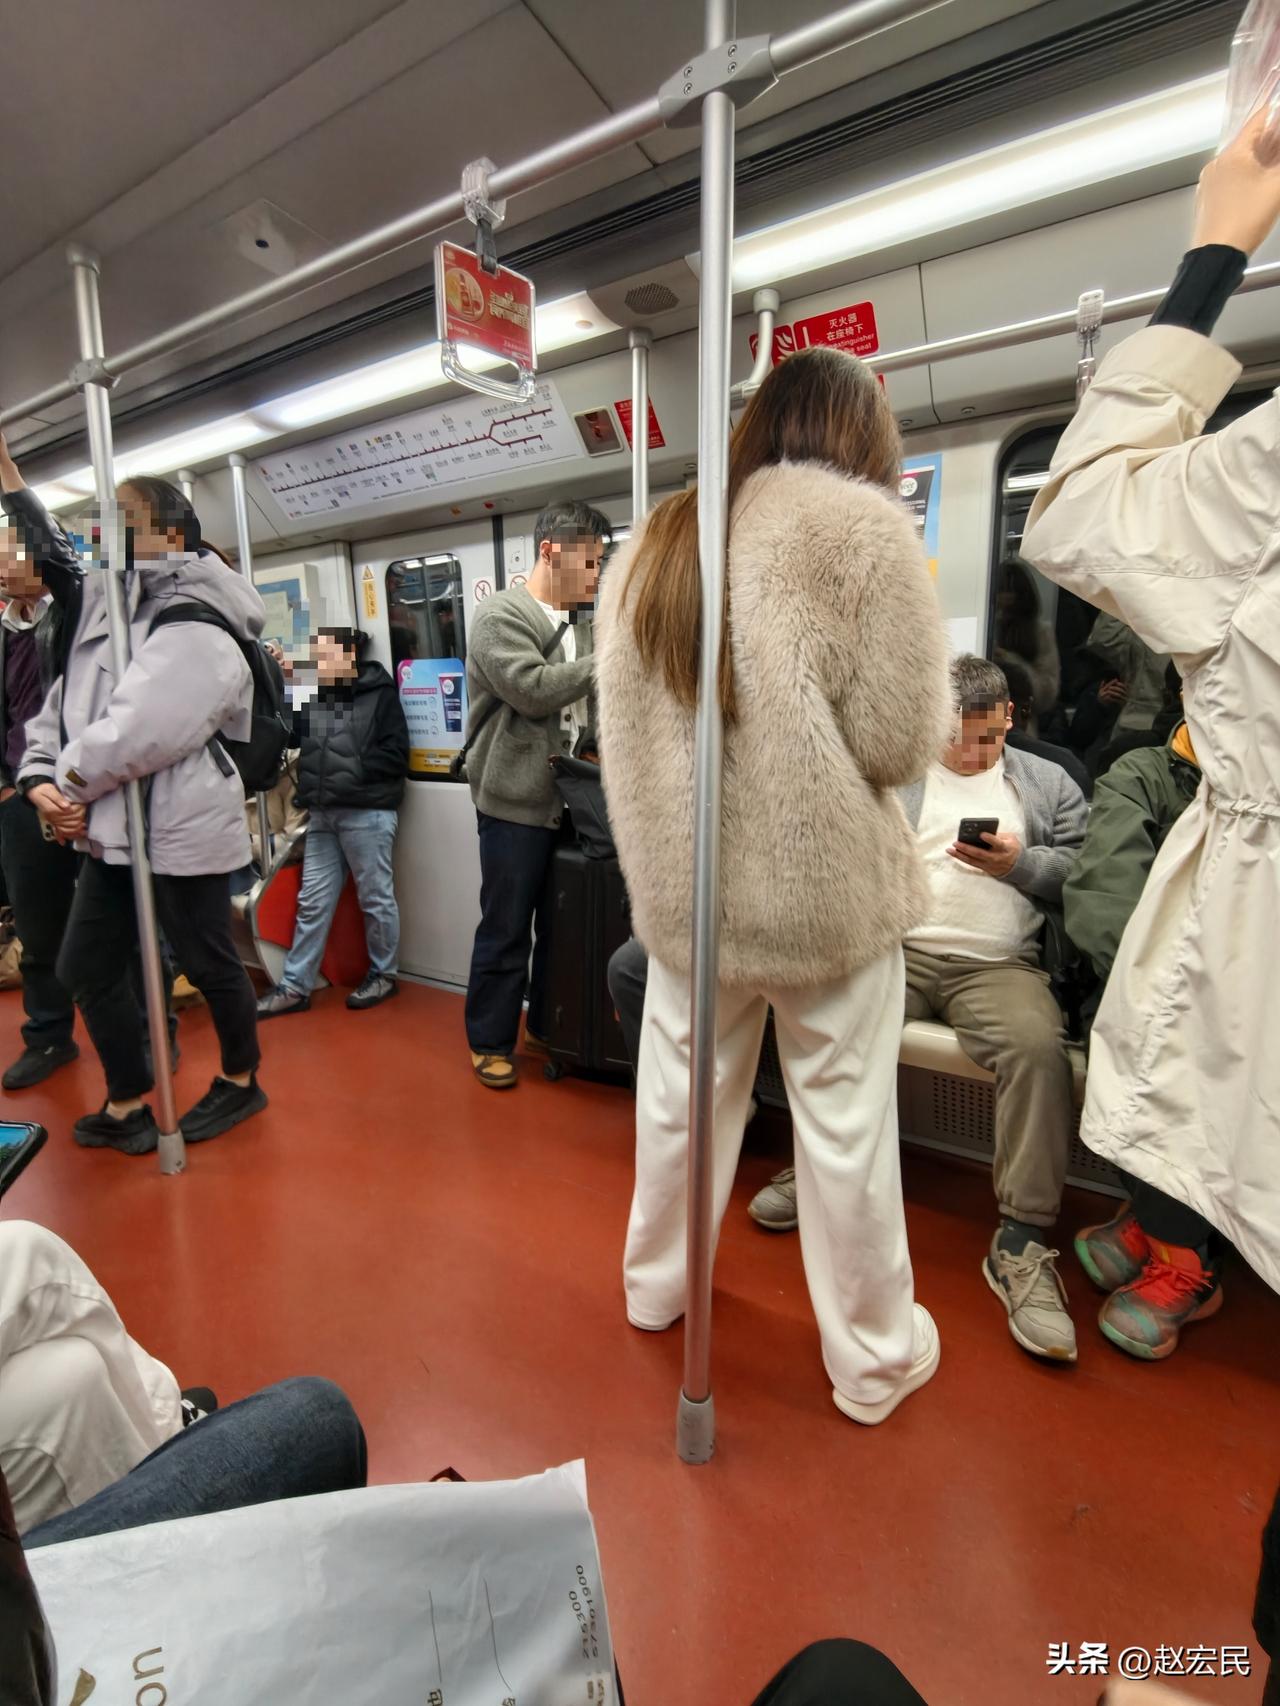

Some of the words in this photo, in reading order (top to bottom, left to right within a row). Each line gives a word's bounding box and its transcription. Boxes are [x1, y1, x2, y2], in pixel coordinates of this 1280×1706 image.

[828, 312, 858, 329] 灭火器
[826, 323, 864, 341] 在座椅下
